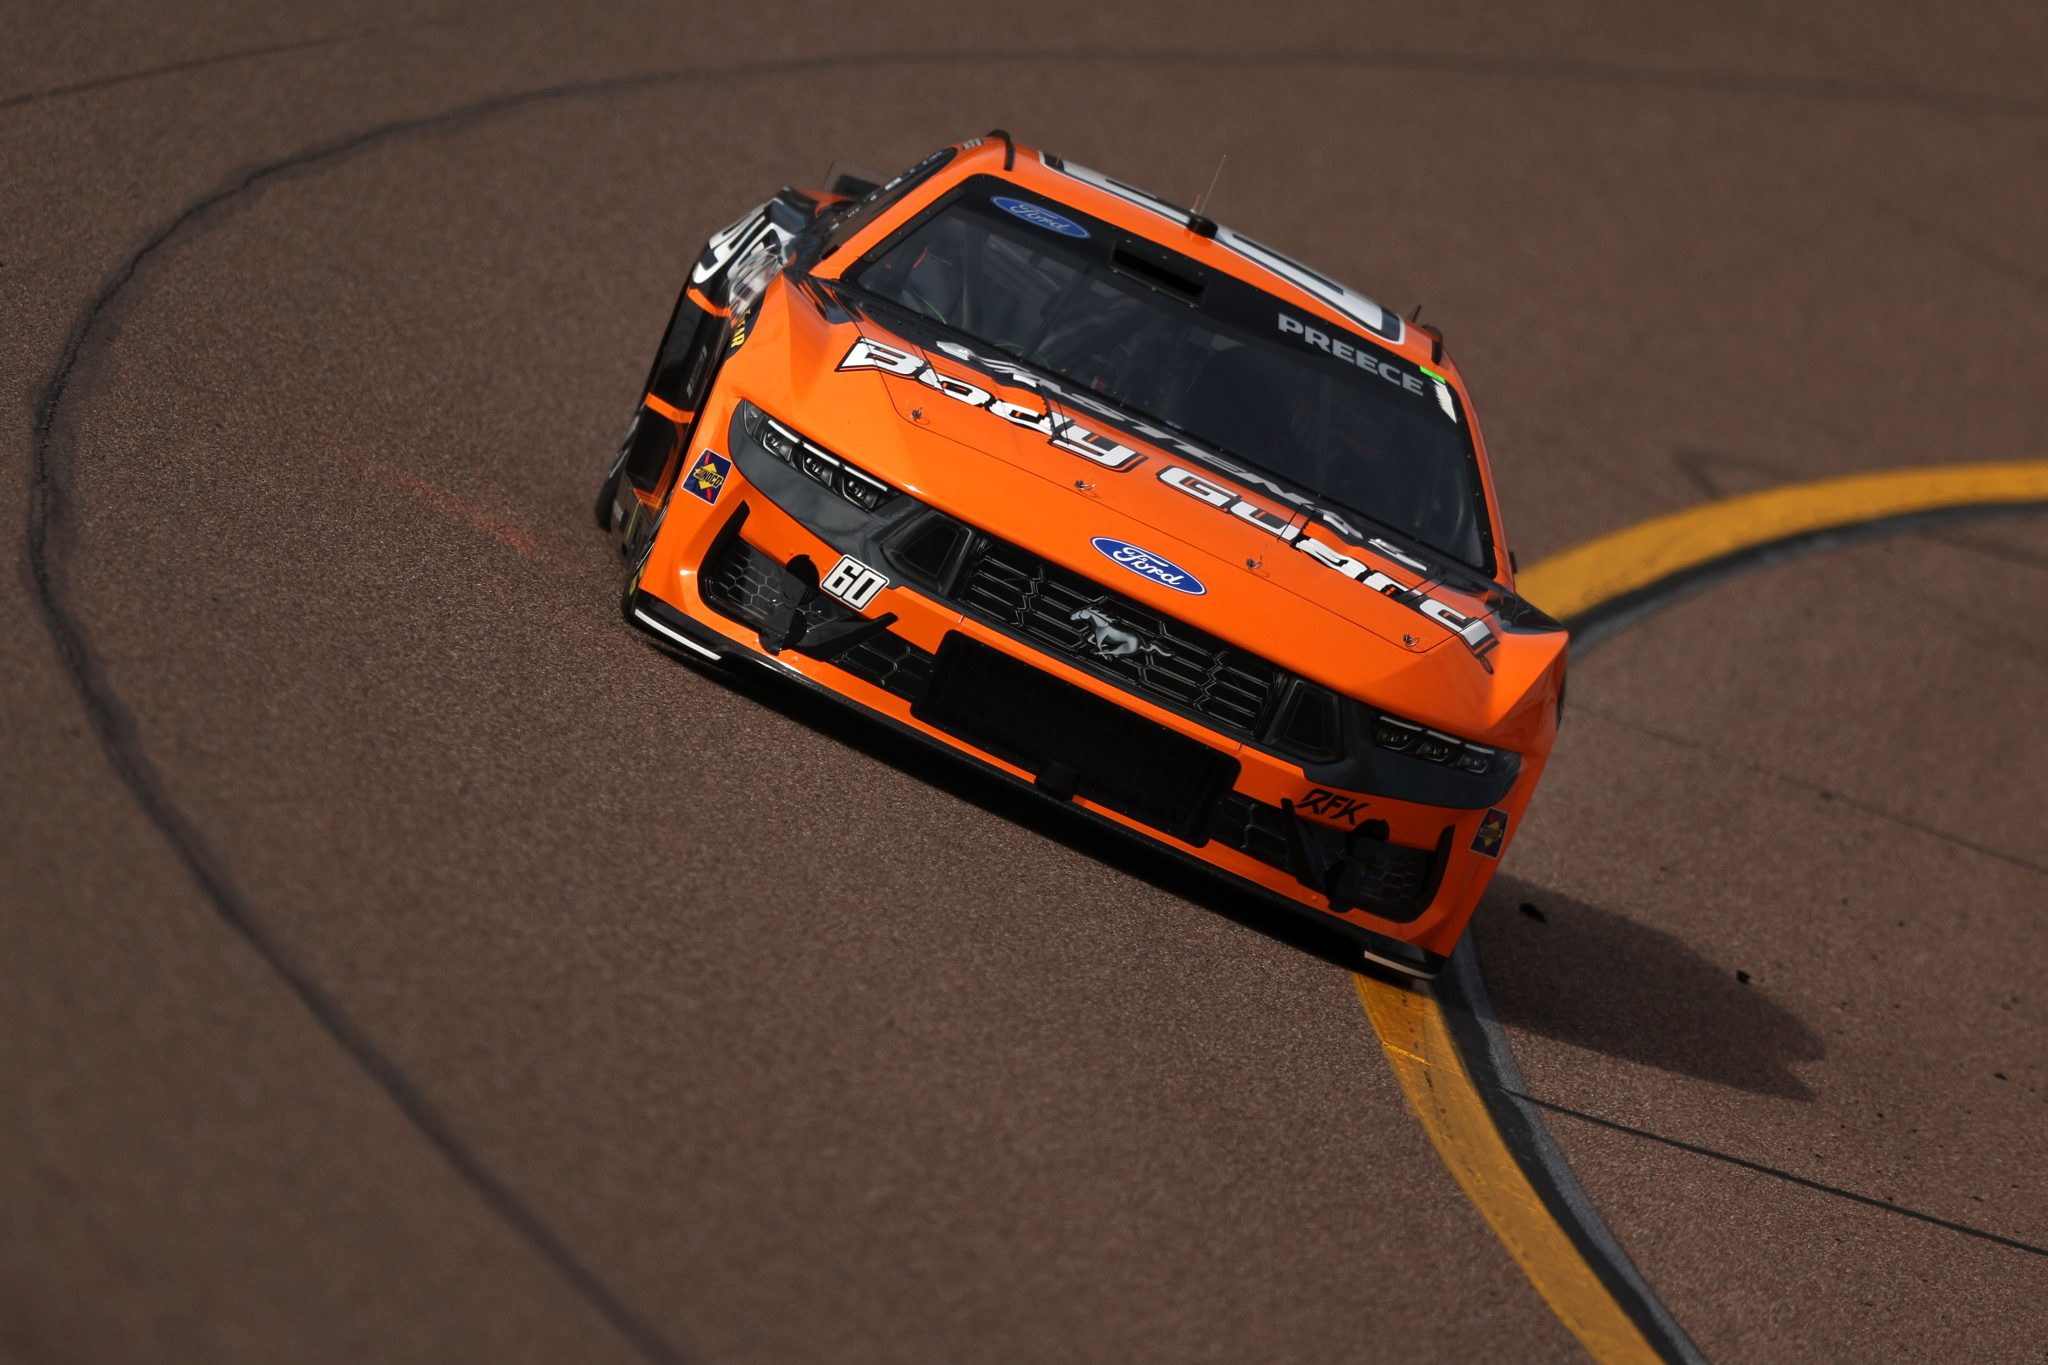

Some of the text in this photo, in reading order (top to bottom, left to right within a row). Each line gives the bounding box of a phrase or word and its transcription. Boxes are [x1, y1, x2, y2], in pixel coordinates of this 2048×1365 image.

[1010, 204, 1071, 231] Ford
[1277, 313, 1424, 397] PREECE
[836, 336, 1497, 658] Body Guard
[821, 555, 889, 611] 60
[1112, 547, 1185, 585] Ford
[1295, 788, 1371, 825] RFK
